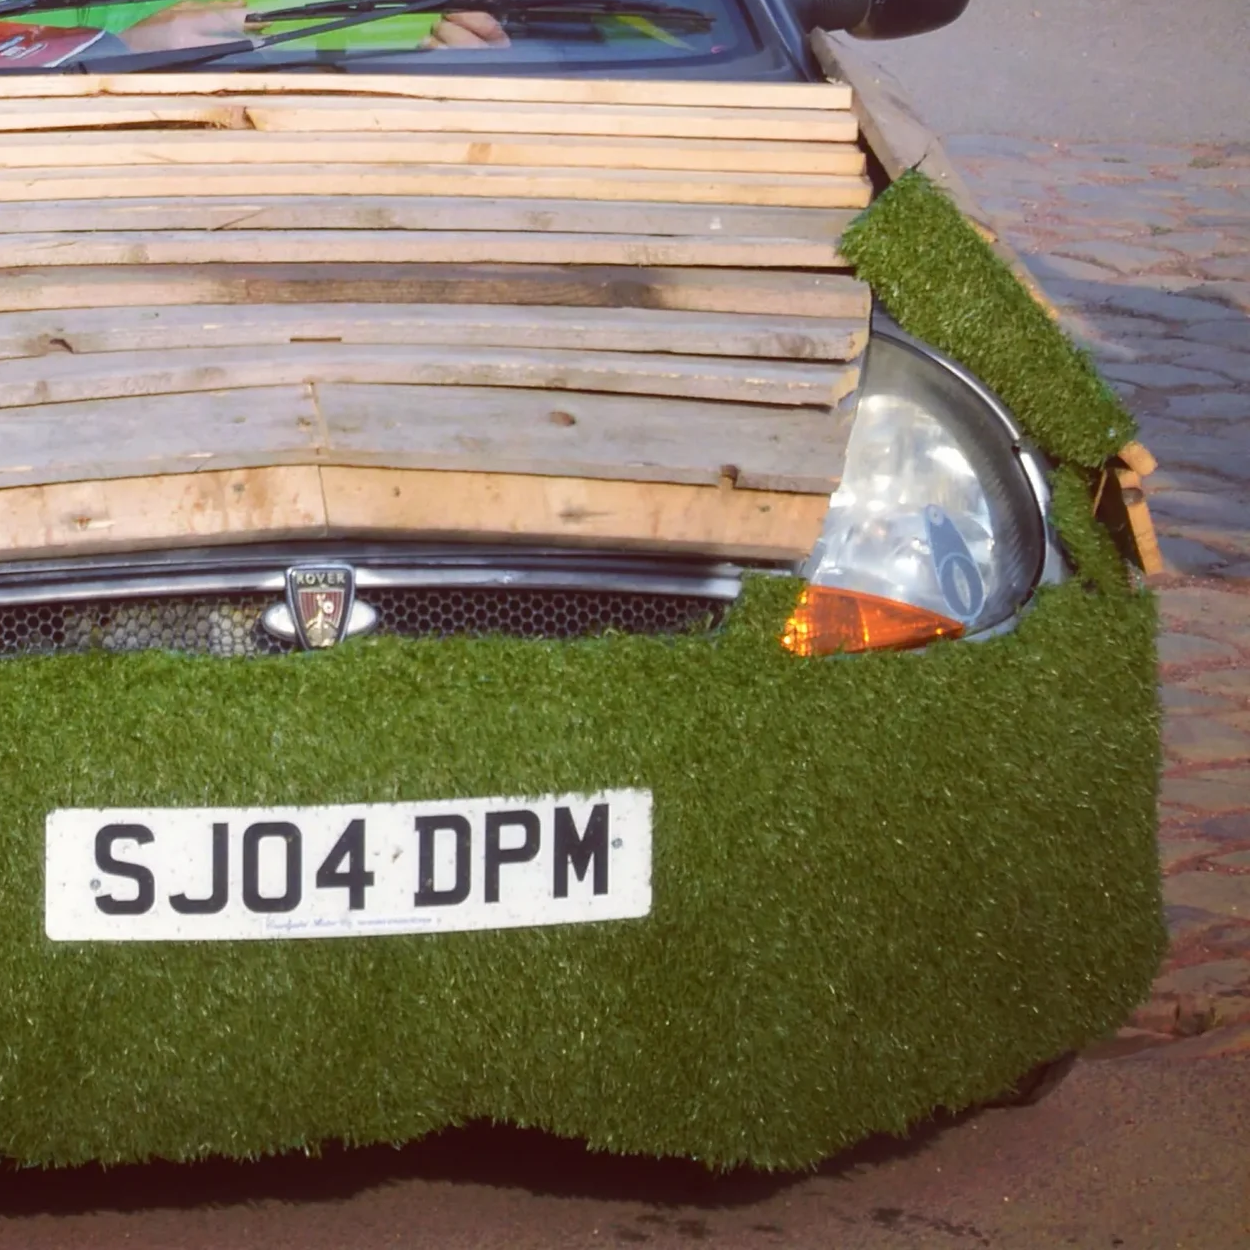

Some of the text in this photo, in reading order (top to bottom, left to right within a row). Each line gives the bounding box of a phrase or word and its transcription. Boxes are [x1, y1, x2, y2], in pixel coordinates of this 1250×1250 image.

[296, 571, 346, 586] ROVER
[94, 802, 610, 916] SJ04 DPM
